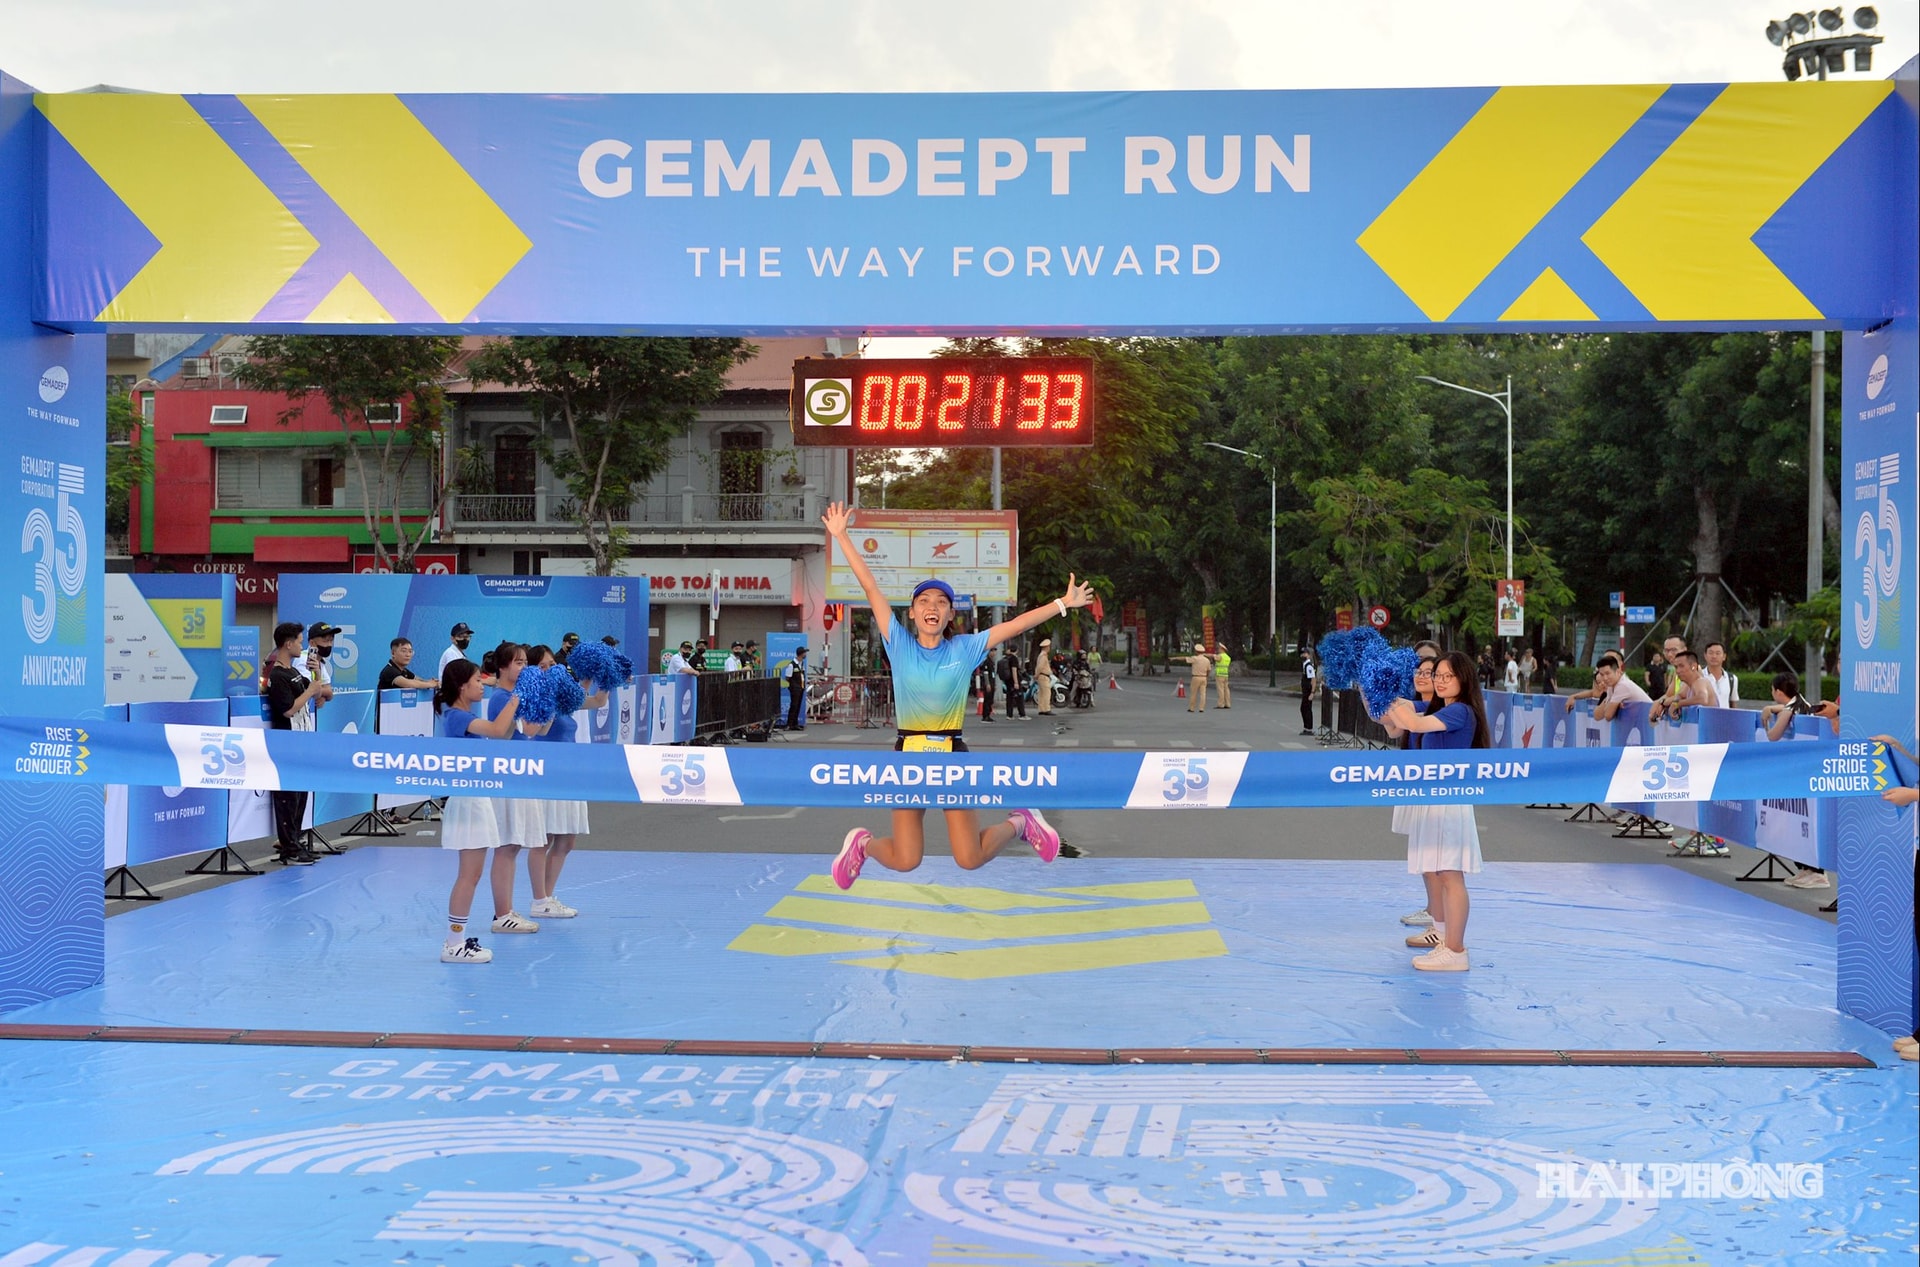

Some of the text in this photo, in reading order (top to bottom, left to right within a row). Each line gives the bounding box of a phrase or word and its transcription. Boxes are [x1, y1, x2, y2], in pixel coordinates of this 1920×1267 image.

[578, 134, 1311, 198] GEMADEPT RUN
[685, 244, 1222, 278] THE WAY FORWARD
[40, 376, 68, 391] GEMADEPT
[27, 406, 80, 428] THE WAY FORWARD
[1859, 401, 1896, 421] THE WAY FORWARD
[21, 455, 55, 479] GEMADEPT
[1855, 458, 1878, 481] GEMADEPT
[21, 479, 55, 499] CORPORATION
[1855, 483, 1878, 501] CORPORATION
[21, 462, 88, 644] 35
[1854, 452, 1901, 650] 35
[193, 563, 246, 574] COFFEE
[263, 577, 279, 594] N
[484, 579, 526, 587] GEMADEPT
[734, 576, 772, 590] NHA
[320, 590, 346, 598] GEMADEPT
[182, 607, 206, 634] 35
[21, 655, 88, 687] ANNIVERSARY
[1853, 660, 1902, 695] ANNIVERSARY
[45, 726, 72, 742] RISE
[29, 742, 72, 758] STRIDE
[200, 733, 247, 776] 35
[1839, 743, 1868, 756] RISE
[15, 758, 71, 775] CONQUER
[351, 751, 545, 776] GEMADEPT RUN
[1329, 762, 1531, 783] GEMADEPT RUN
[1642, 746, 1690, 791] 35
[1822, 758, 1868, 774] STRIDE
[200, 777, 246, 786] ANNIVERSARY
[395, 775, 504, 789] SPECIAL EDITION
[660, 754, 706, 796] 35
[809, 763, 1058, 787] GEMADEPT RUN
[1162, 758, 1210, 802] 35
[1809, 775, 1870, 792] CONQUER
[863, 793, 1003, 805] SPECIAL EDITION
[1371, 786, 1485, 798] SPECIAL EDITION
[1643, 791, 1691, 800] ANNIVERSARY
[154, 805, 206, 822] THE WAY FORWARD
[328, 1059, 899, 1087] GEMADEPT
[289, 1083, 899, 1110] CORPORATION
[1217, 1169, 1330, 1198] th
